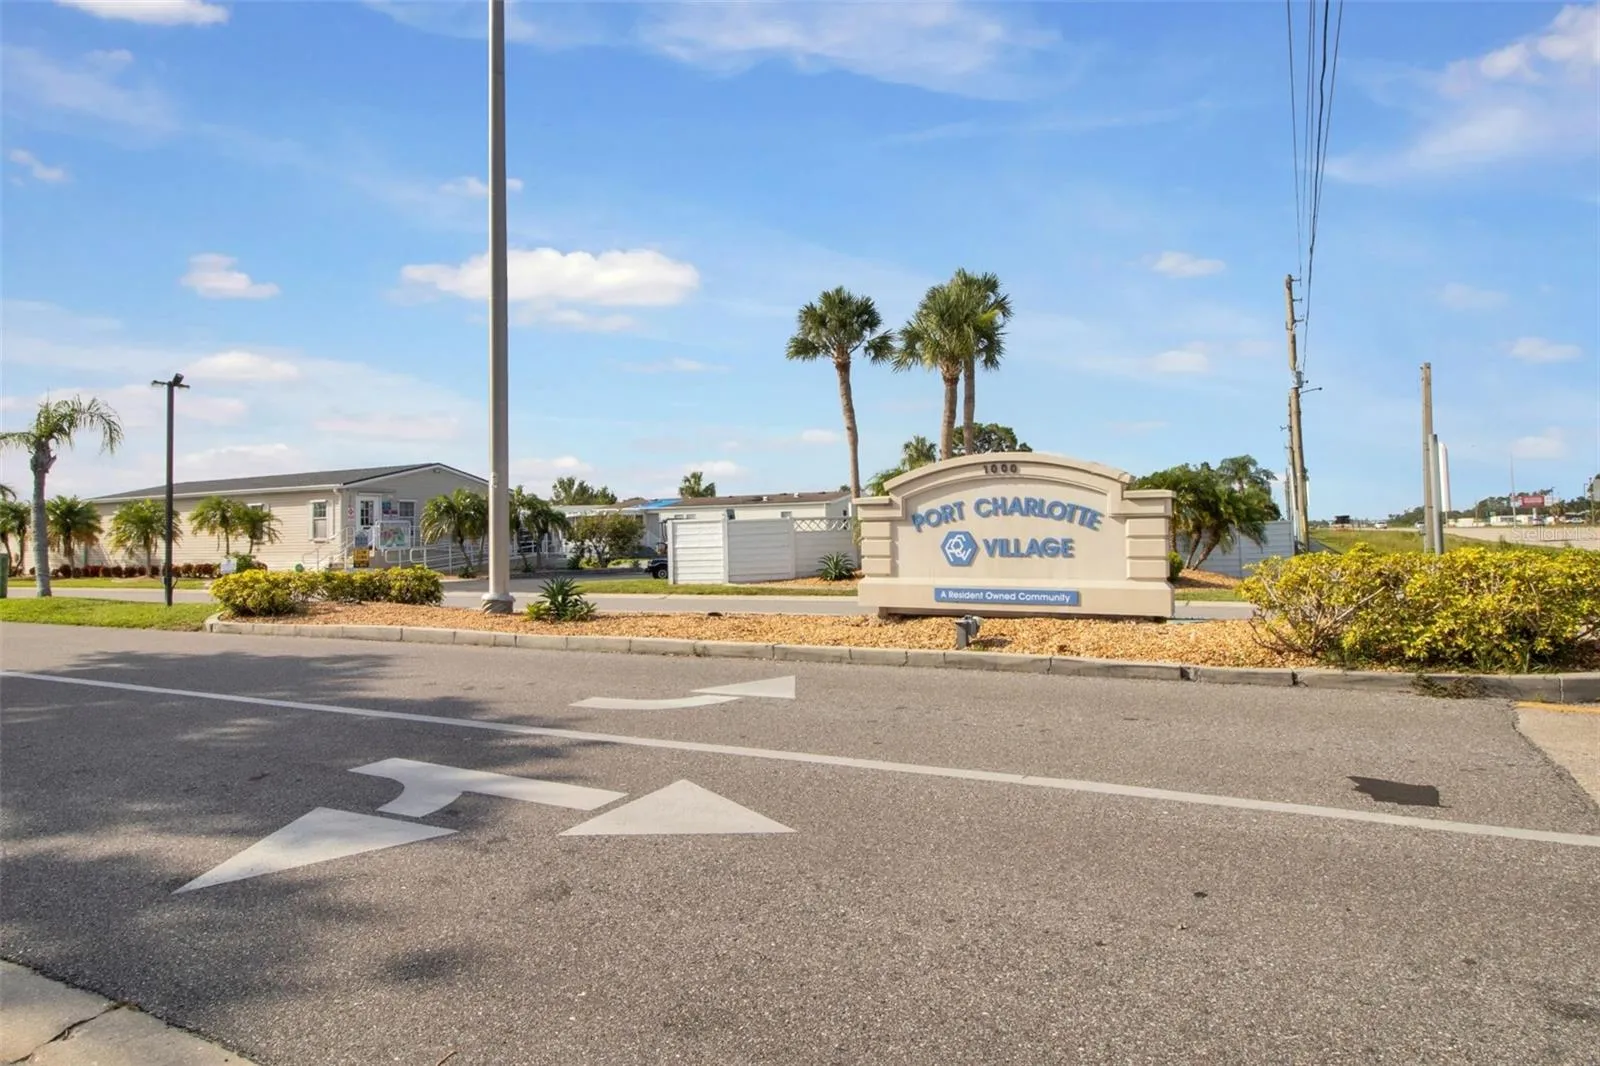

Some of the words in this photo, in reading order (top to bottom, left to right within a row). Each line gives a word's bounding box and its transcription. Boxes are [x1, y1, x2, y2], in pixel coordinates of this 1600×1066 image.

[983, 464, 1019, 475] 1000
[911, 501, 966, 533] PORT
[974, 496, 1105, 532] CHARLOTTE
[983, 538, 1075, 559] VILLAGE
[940, 591, 947, 599] A
[948, 591, 983, 600] Resident
[985, 592, 1016, 601] Owned
[1018, 592, 1071, 603] Community
